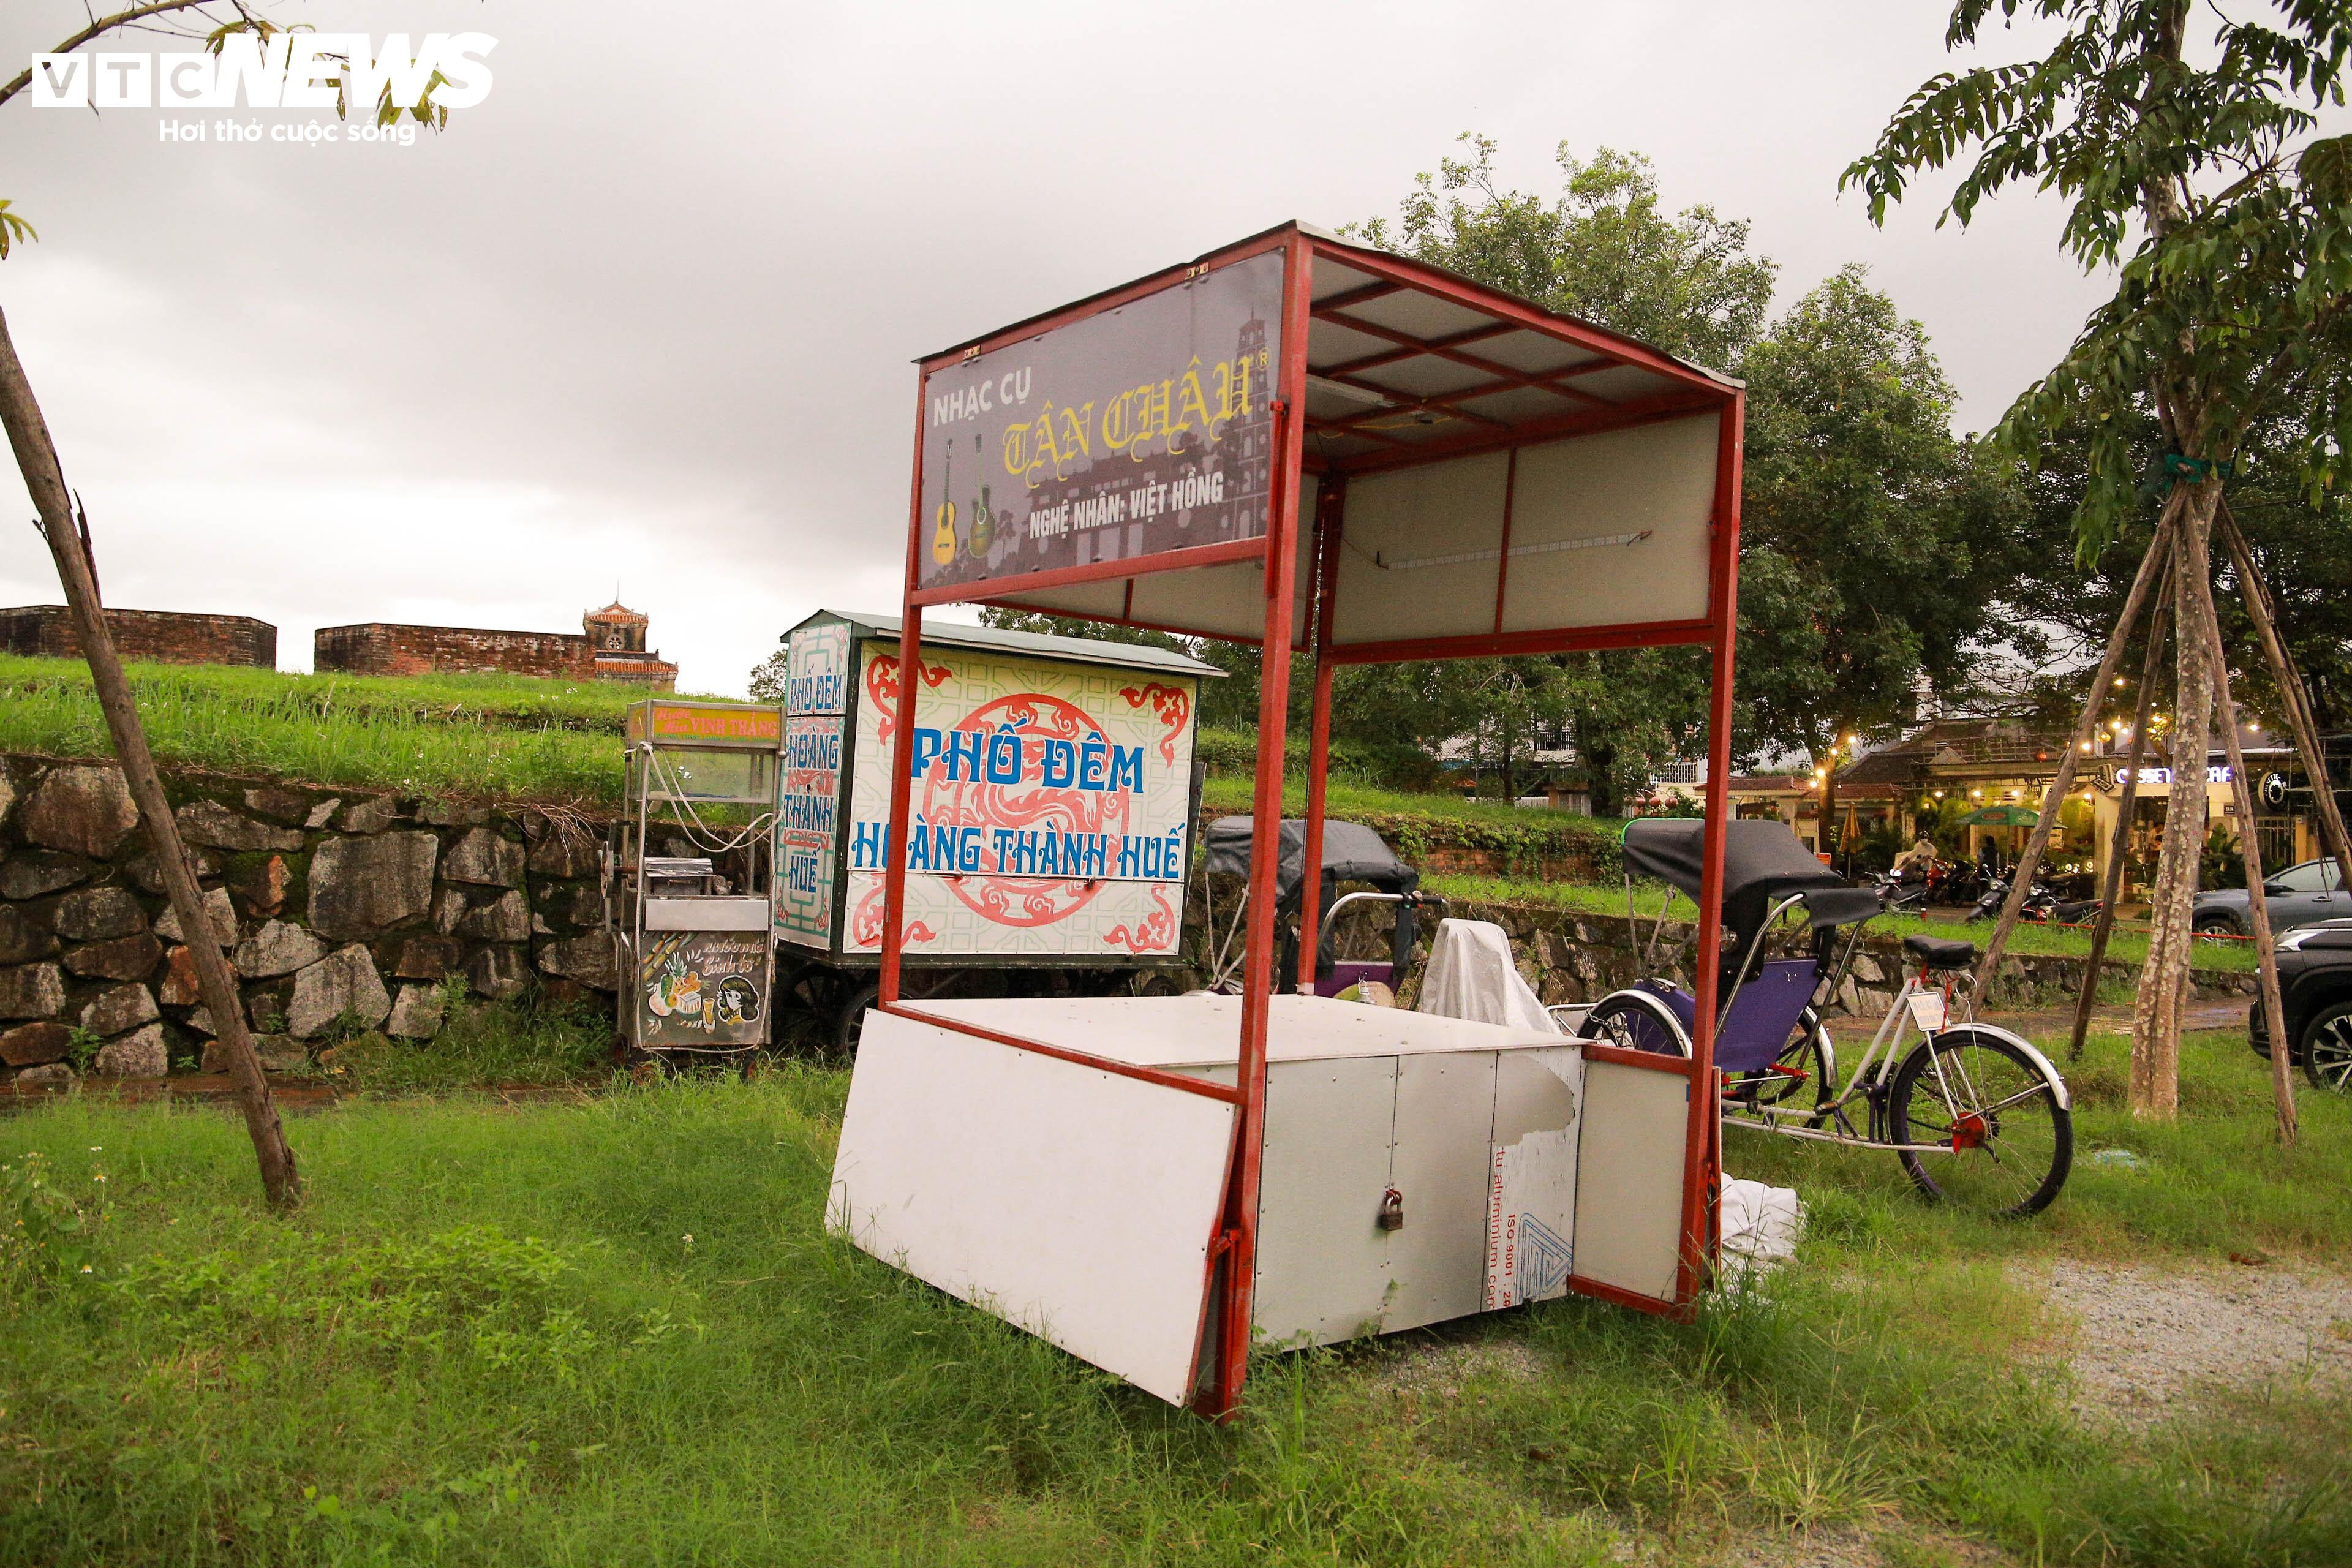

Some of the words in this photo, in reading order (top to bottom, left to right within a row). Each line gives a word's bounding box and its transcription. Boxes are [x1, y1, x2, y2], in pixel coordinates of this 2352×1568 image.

[933, 380, 993, 427] NHẠC
[1000, 366, 1031, 405] CỤ
[1003, 399, 1095, 489] TÂN
[1102, 353, 1254, 462] CHÂU
[1030, 499, 1069, 539] NGHỆ
[1074, 490, 1125, 530] NHÂN:
[1130, 480, 1167, 522] VIỆT
[1171, 466, 1224, 511] HỒNG
[789, 663, 814, 712] PHỐ
[816, 667, 843, 710] ĐÊM
[787, 725, 839, 770] HOÀNG
[910, 717, 1028, 785] PHỐ
[1041, 732, 1144, 794] ĐÊM
[784, 790, 834, 832] THÀNH
[788, 845, 821, 893] HUẾ
[851, 813, 981, 872] HÀNG
[993, 820, 1108, 876] THÀNH
[1117, 822, 1186, 878] HUẾ
[1488, 1175, 1504, 1268] aluminium
[1506, 1214, 1516, 1240] ISO
[1504, 1245, 1514, 1277] 9001
